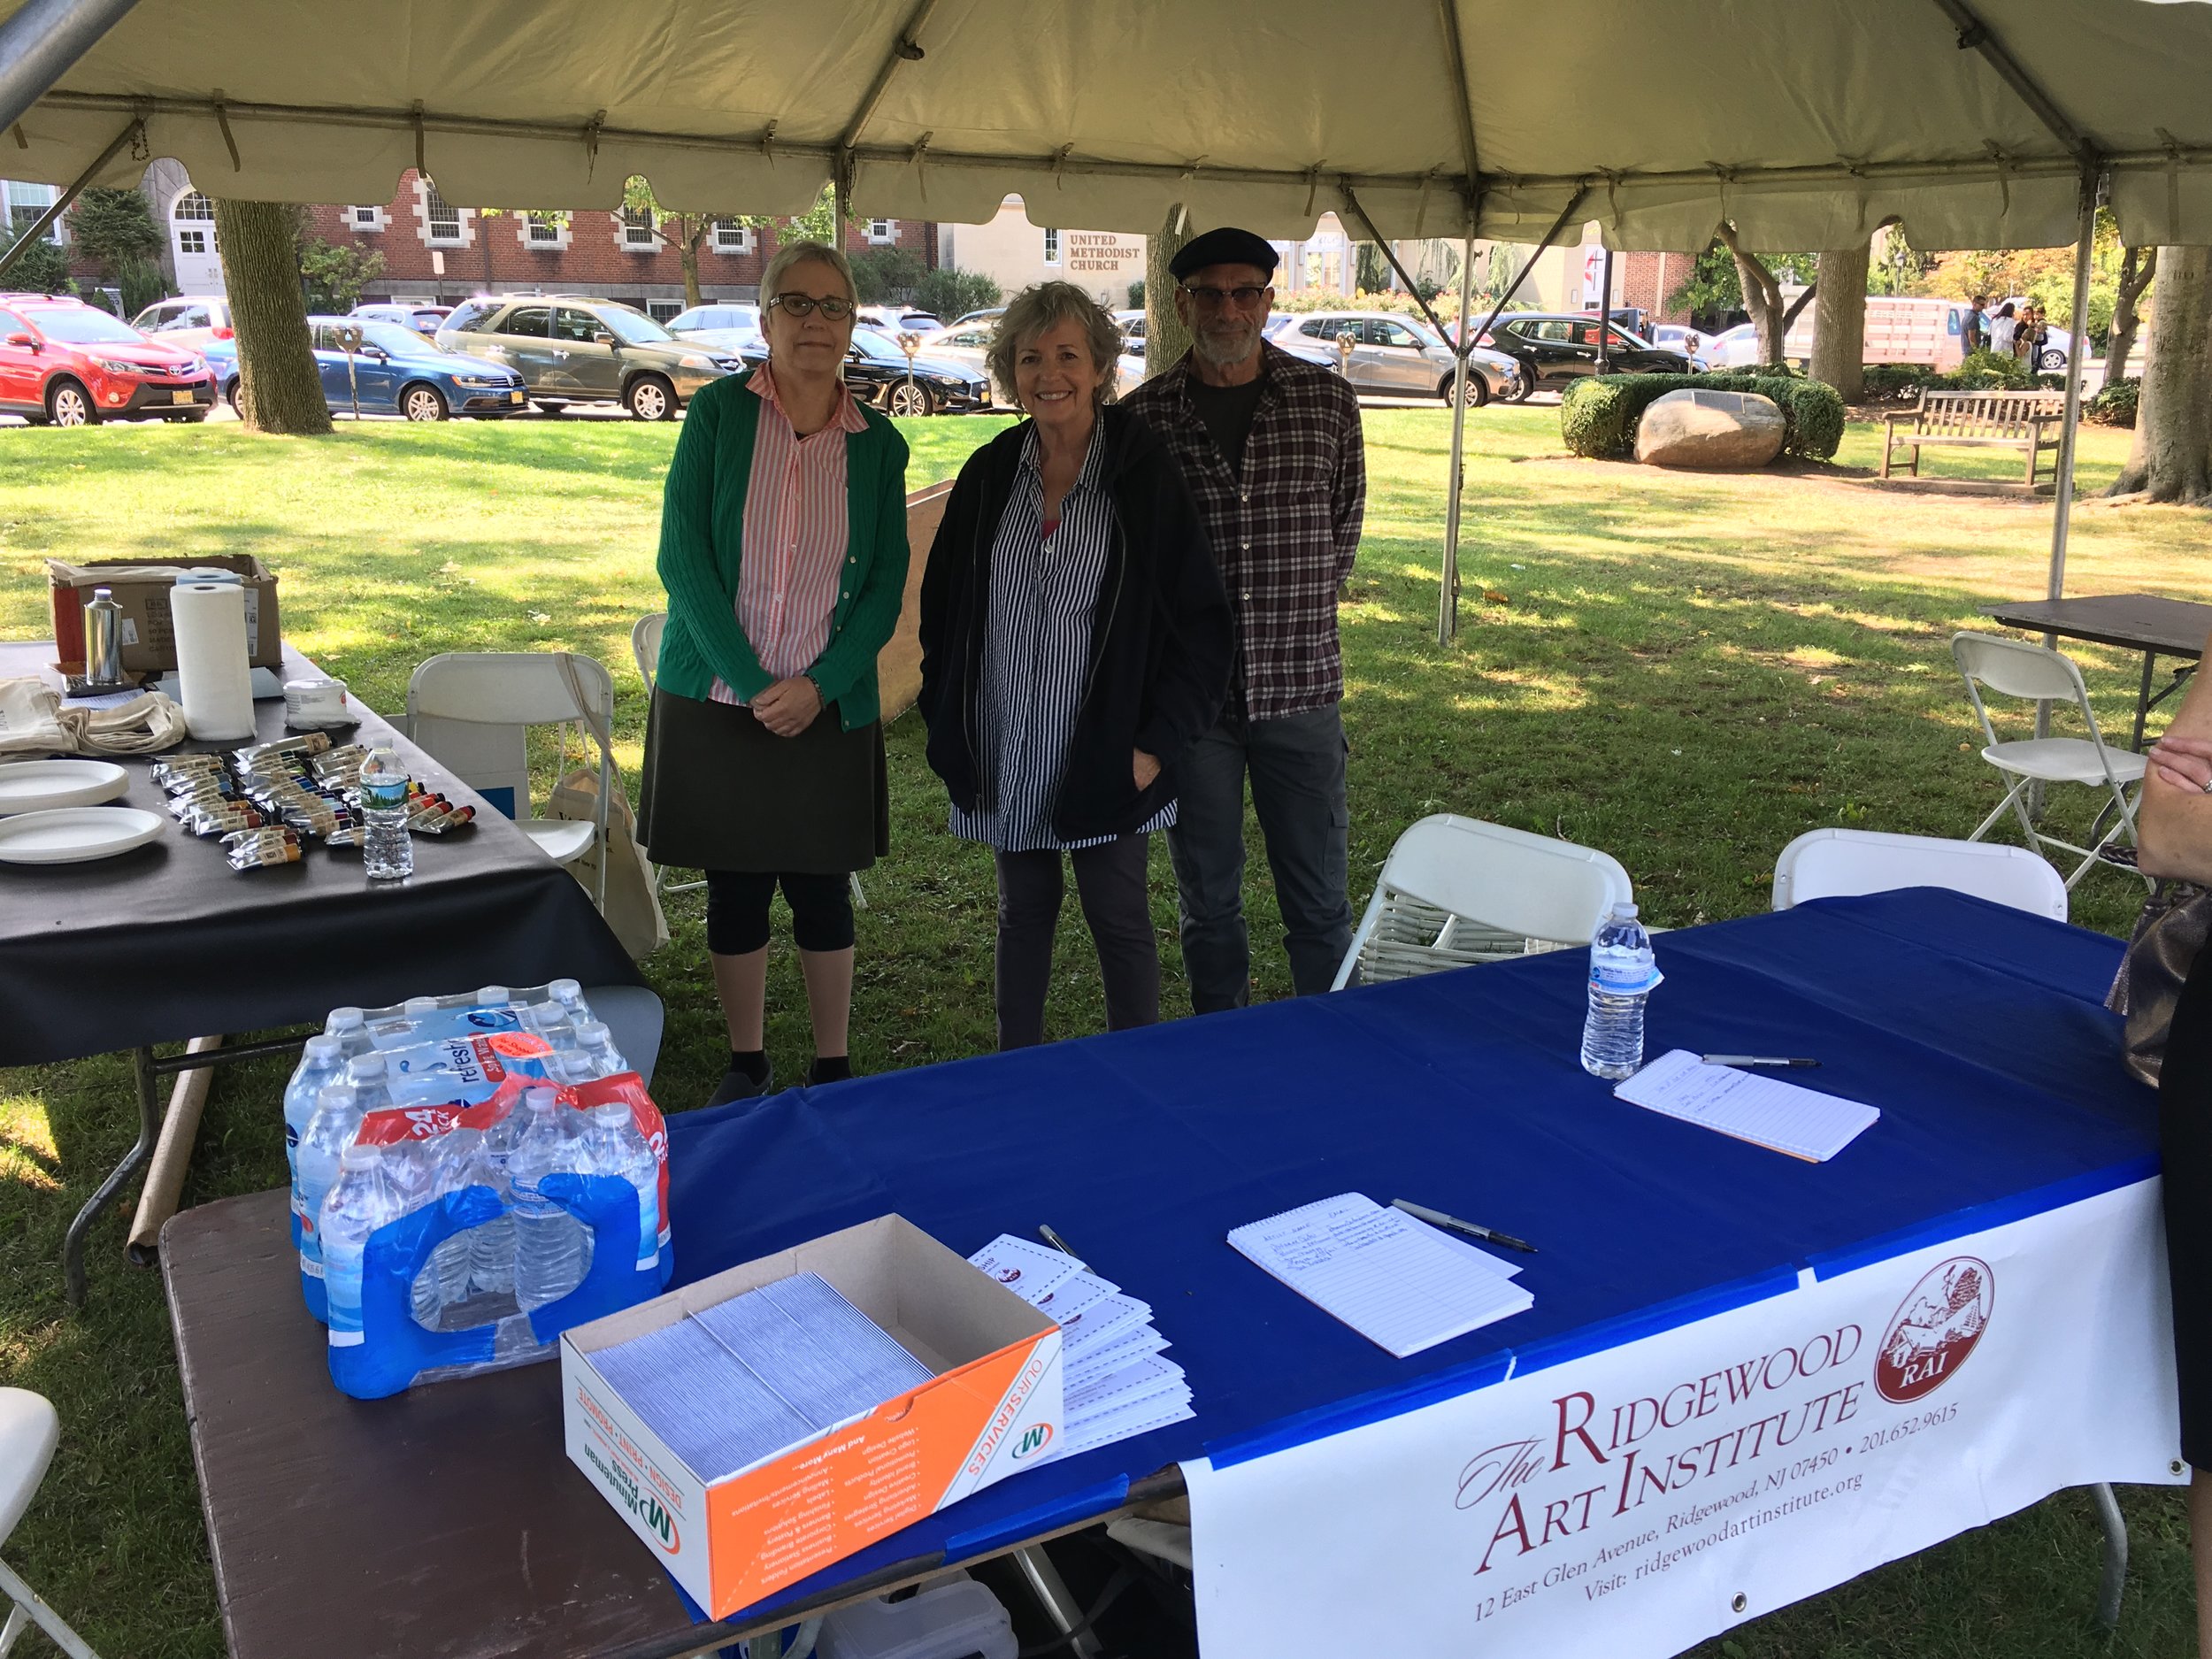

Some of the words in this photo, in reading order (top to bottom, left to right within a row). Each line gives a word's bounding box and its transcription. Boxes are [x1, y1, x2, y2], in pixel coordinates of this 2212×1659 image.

[1070, 234, 1117, 246] UNITED
[1070, 248, 1141, 258] METHODIST
[1070, 260, 1118, 271] CHURCH
[404, 1109, 439, 1137] 24
[1018, 1359, 1042, 1395] OUR
[1899, 1352, 1949, 1390] RAI
[578, 1386, 614, 1436] PROMOTE
[1455, 1434, 1548, 1510] The
[1548, 1324, 1863, 1472] RIDGEWOOD
[848, 1435, 866, 1449] And
[887, 1428, 916, 1446] Website
[968, 1393, 1022, 1476] SERVICES
[618, 1434, 644, 1467] PRINT
[823, 1443, 847, 1460] Many
[862, 1440, 887, 1455] Design
[897, 1440, 916, 1451] Logo
[867, 1448, 897, 1465] Creation
[584, 1443, 638, 1516] Minuteman
[611, 1460, 639, 1499] Press
[649, 1466, 683, 1509] DESIGN
[803, 1479, 829, 1494] Mailing
[844, 1471, 875, 1487] Products
[889, 1472, 917, 1489] Creative
[1473, 1485, 1607, 1576] ART
[1611, 1382, 1866, 1517] INSTITUTE
[772, 1490, 803, 1509] Services
[806, 1490, 831, 1505] Labels
[864, 1484, 888, 1501] Design
[798, 1502, 831, 1520] Finishing
[843, 1502, 879, 1521] Strategies
[883, 1494, 917, 1513] Marketing
[1475, 1597, 1495, 1623] 12
[1501, 1581, 1539, 1609] East
[1543, 1562, 1588, 1588] Glen
[1593, 1527, 1659, 1568] Avenue,
[1665, 1479, 1760, 1534] Ridgewood,
[1764, 1469, 1787, 1492] NJ
[1790, 1447, 1839, 1481] 07450
[1858, 1402, 1960, 1455] 201.652.9615
[764, 1516, 797, 1536] Solutions
[802, 1513, 831, 1529] Banners
[854, 1510, 883, 1527] Services
[866, 1516, 895, 1532] Services
[766, 1529, 794, 1546] Posters
[795, 1524, 832, 1544] Corporate
[1585, 1574, 1627, 1601] Visit:
[1634, 1471, 1864, 1580] ridgewoodartinstitute.org
[760, 1540, 795, 1561] Branding
[801, 1535, 833, 1553] Business
[764, 1548, 801, 1571] Stationery
[788, 1547, 833, 1571] Presentation
[761, 1568, 788, 1585] Folders
